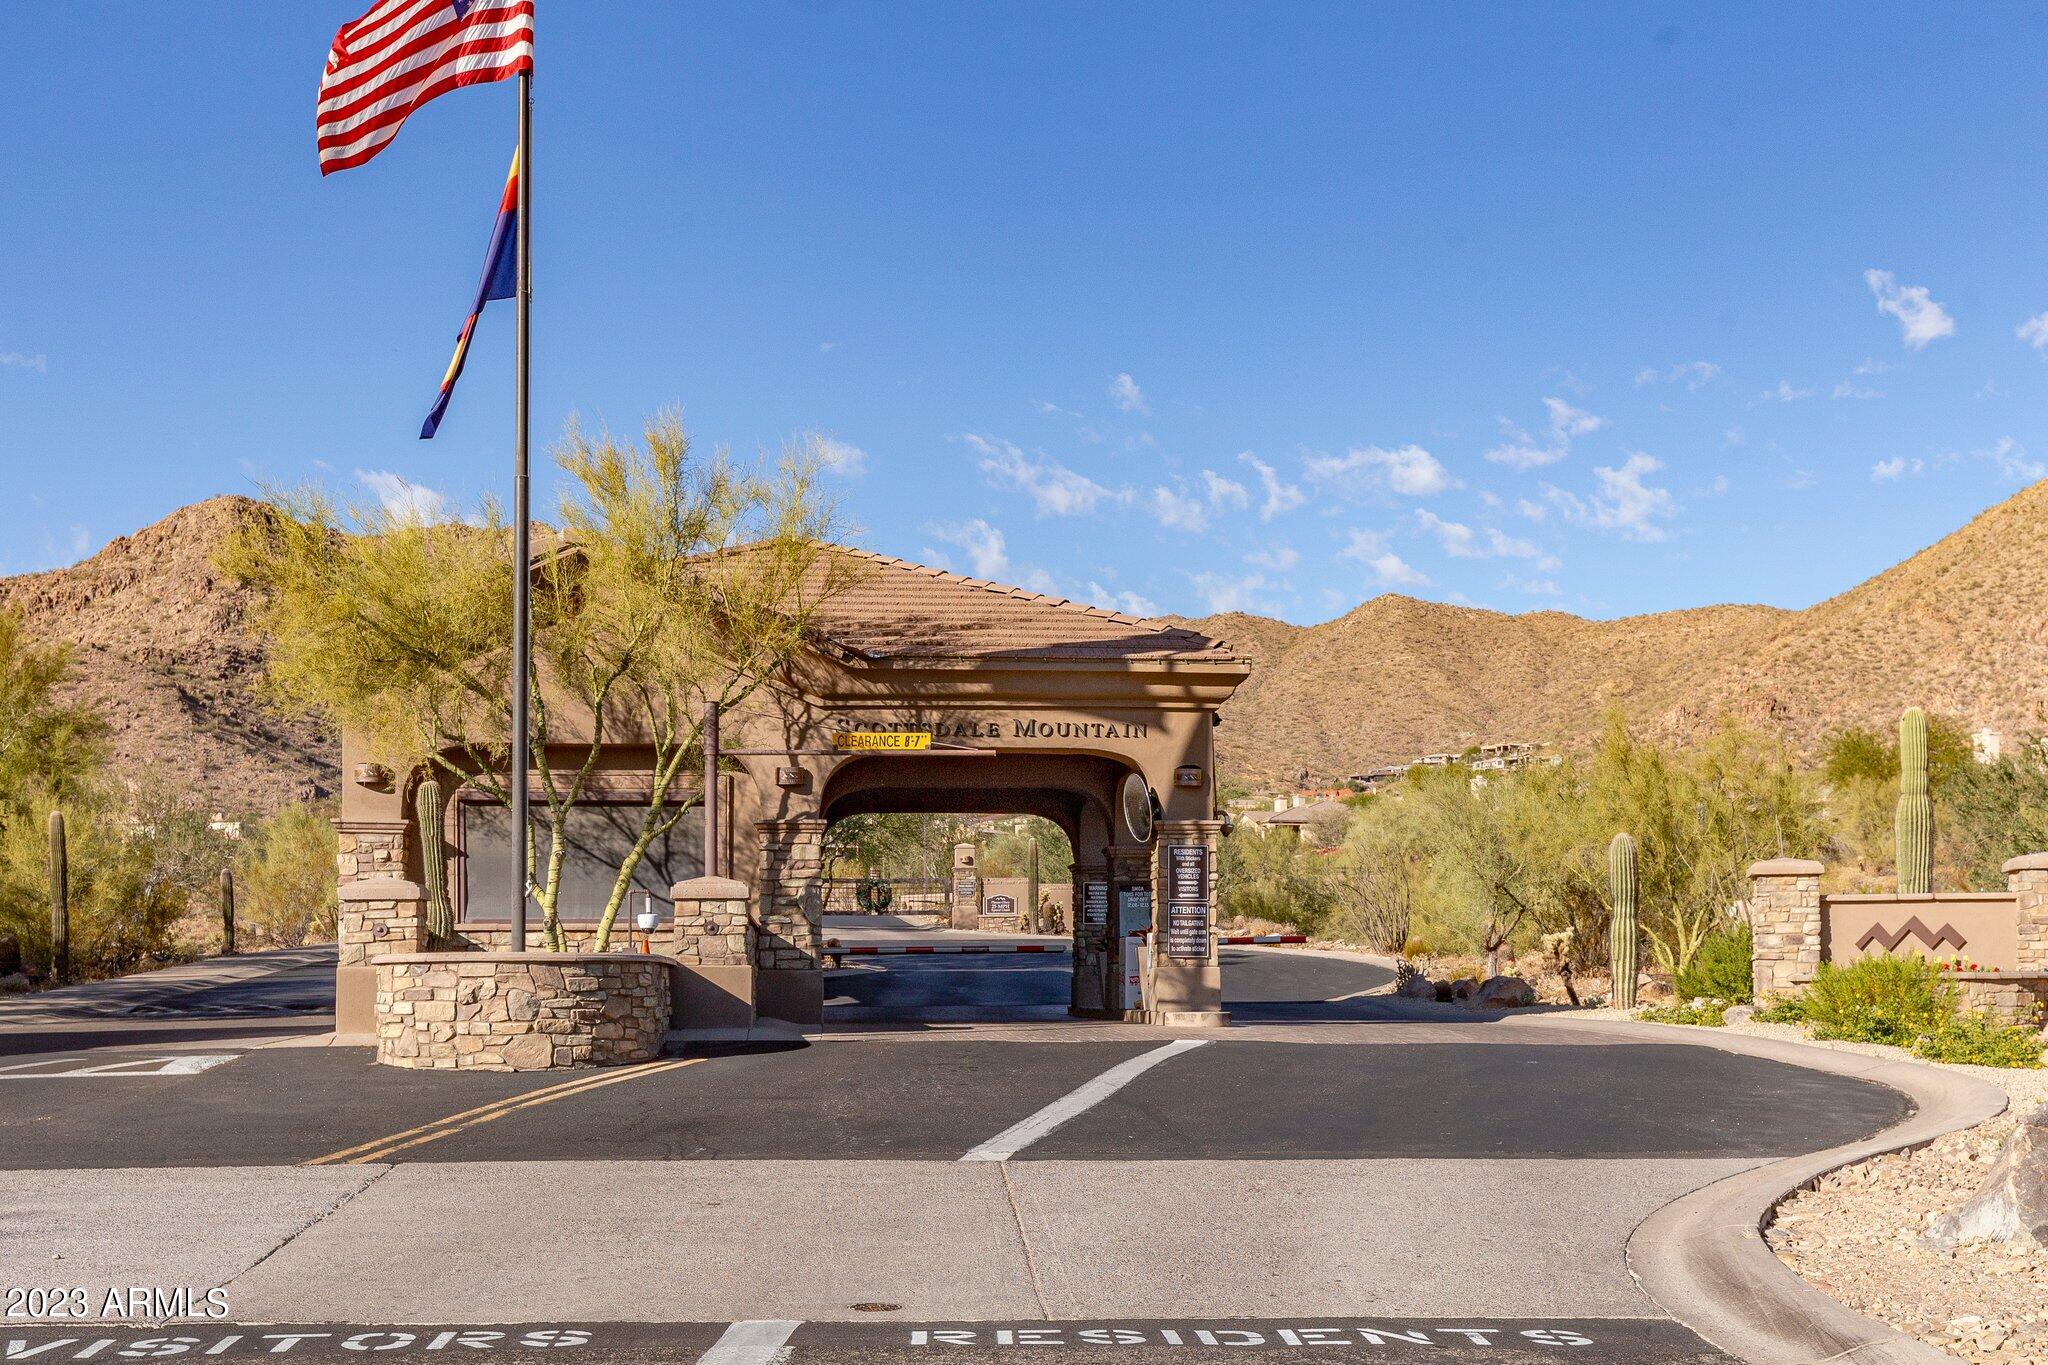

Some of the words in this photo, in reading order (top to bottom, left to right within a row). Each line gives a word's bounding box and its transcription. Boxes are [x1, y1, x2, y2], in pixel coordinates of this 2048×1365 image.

[1013, 718, 1148, 738] MOUNTAIN
[837, 735, 900, 747] CLEARANCE
[1171, 906, 1206, 914] ATTENTION
[5, 1330, 594, 1359] VISITORS
[910, 1328, 1595, 1347] RESIDENTS
